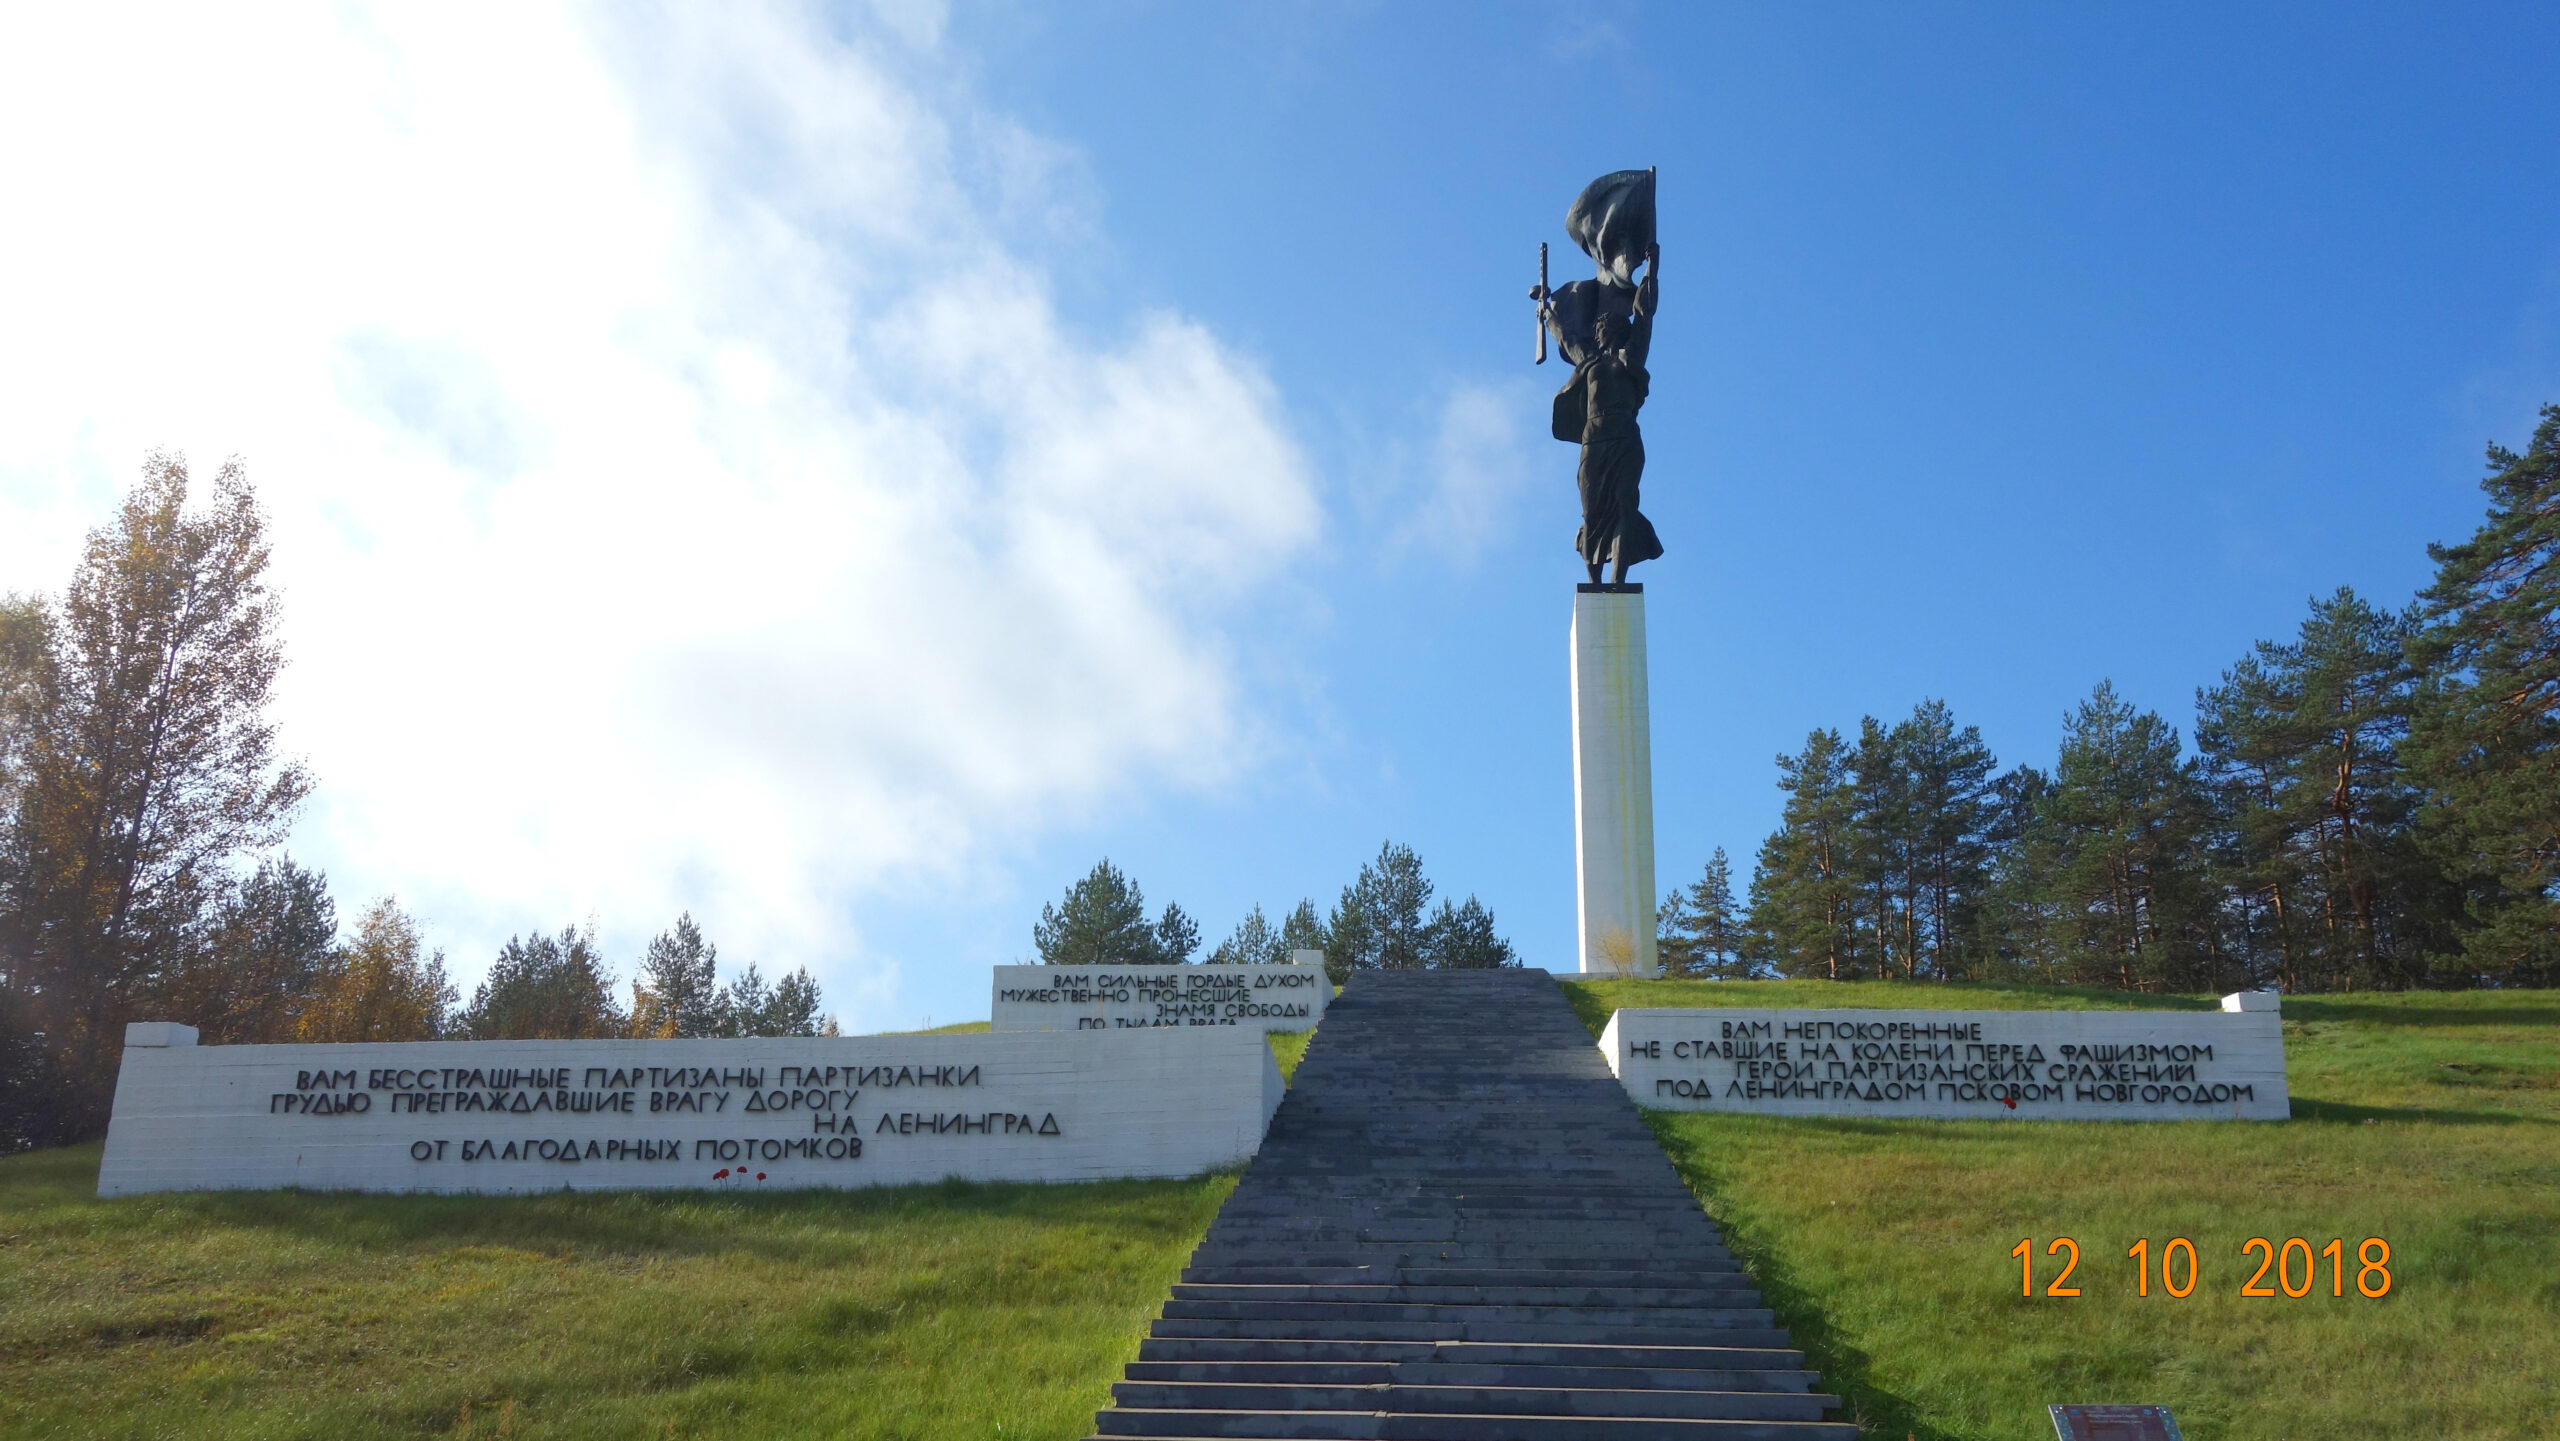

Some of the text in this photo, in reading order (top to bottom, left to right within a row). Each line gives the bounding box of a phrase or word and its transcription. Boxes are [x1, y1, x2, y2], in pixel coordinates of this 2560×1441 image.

[1054, 975, 1314, 988] ВАМ СИЛЬНЫЕ ГОРДЫЕ ДУХОМ
[1001, 989, 1250, 1002] МУЖЕСТВЕННО ПРОНЕСШИЕ
[1157, 1004, 1308, 1017] ЗНАМЯ СВОБОДЫ
[1080, 1018, 1104, 1030] ПО
[1723, 1022, 1981, 1040] ВАМ НЕПОКОРЕННЫЕ
[1631, 1041, 2212, 1062] НЕ СТАВШИЕ НА КОЛЕНИ ПЕРЕД ФАШИЗМОМ
[296, 1066, 979, 1090] ВАМ БЕССТРАШНЫЕ ПАРТИЗАНЫ ПАРТИЗАНКИ
[1737, 1062, 2195, 1082] ГЕРОИ ПАРТИЗАНСКИХ СРАЖЕНИЙ
[271, 1090, 859, 1113] ГРУДЬЮ ПРЕГРАЖДАВШИЕ ВРАГУ ДОРОГУ
[1657, 1080, 2253, 1103] ПОД ЛЕНИНГРАДОМ ПСКОВОМ НОВГОРОДОМ
[815, 1113, 1060, 1135] НА ЛЕНИНГРАД
[411, 1137, 862, 1161] ОТ БЛАГОДАРНЫХ ПОТОМКОВ
